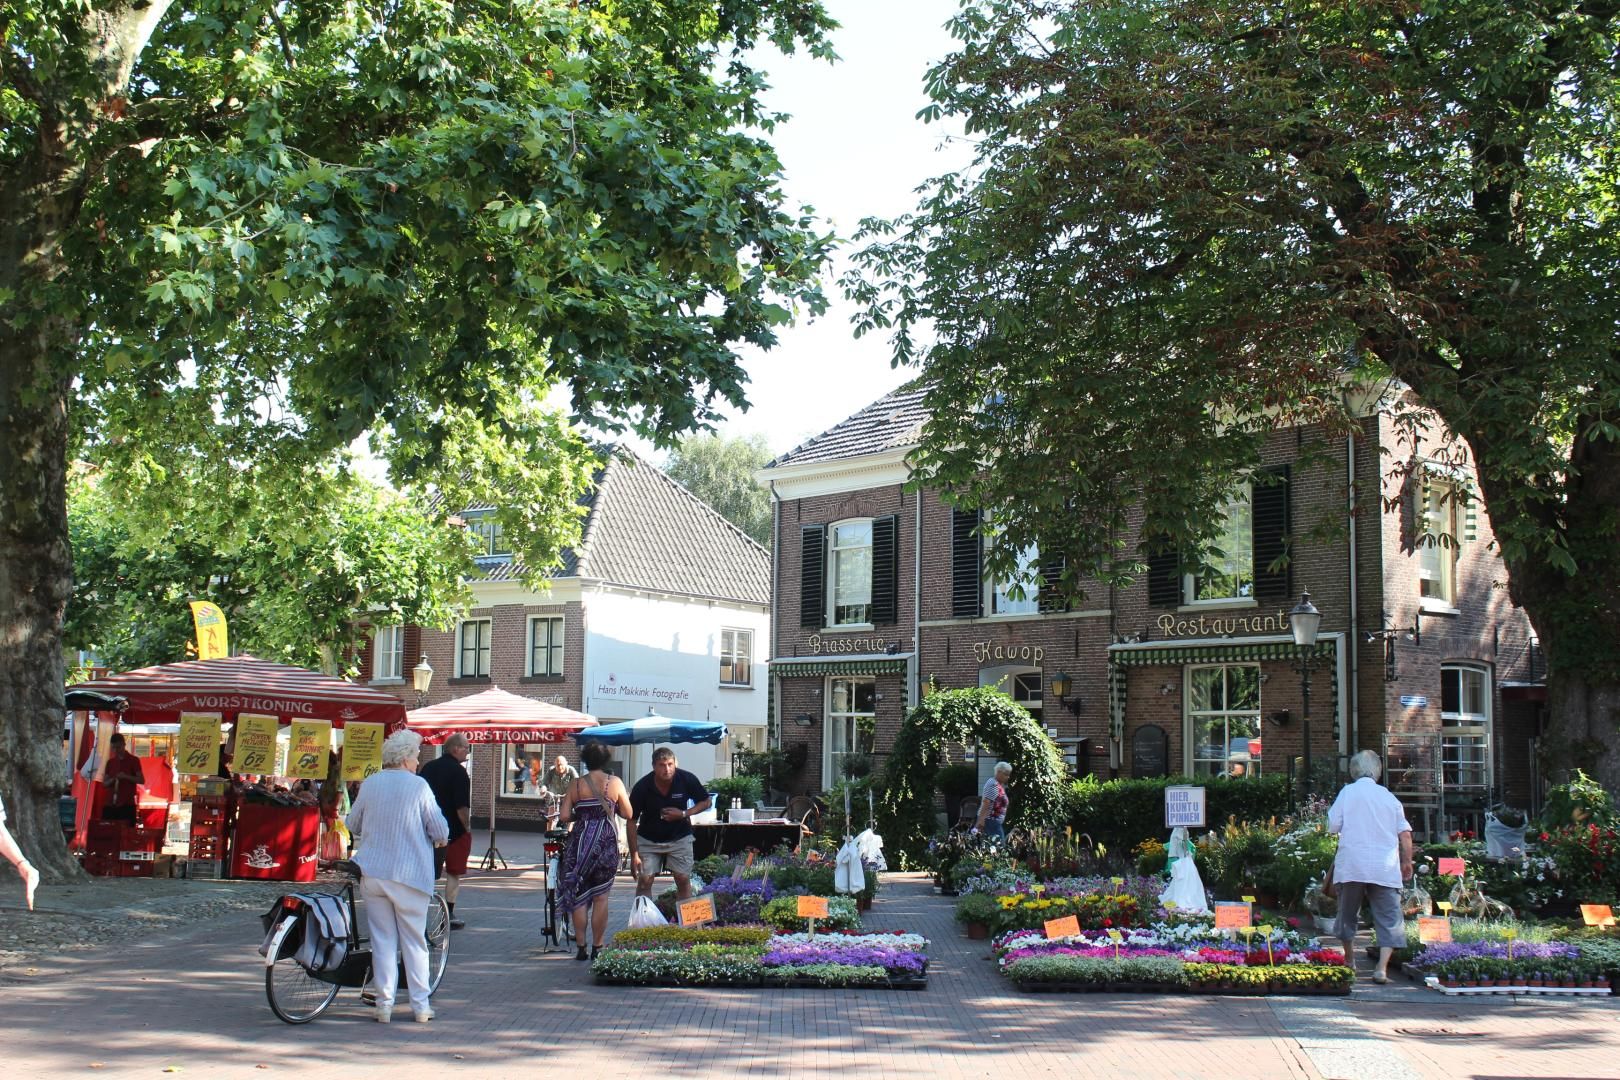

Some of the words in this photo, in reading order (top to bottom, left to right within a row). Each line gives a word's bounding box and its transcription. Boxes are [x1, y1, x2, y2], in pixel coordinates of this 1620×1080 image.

[1157, 609, 1289, 636] Restaurant
[808, 634, 884, 654] Brasserie
[973, 639, 1044, 668] Kawop
[598, 684, 617, 695] Hans
[619, 685, 650, 697] Makkink
[651, 687, 689, 701] Fotografie
[192, 695, 313, 714] WORSTKONING
[452, 730, 555, 742] ORSTKONING
[1169, 791, 1189, 802] HIER
[1169, 801, 1192, 813] KUNT
[1192, 801, 1199, 812] U
[1169, 812, 1200, 823] PINNEN
